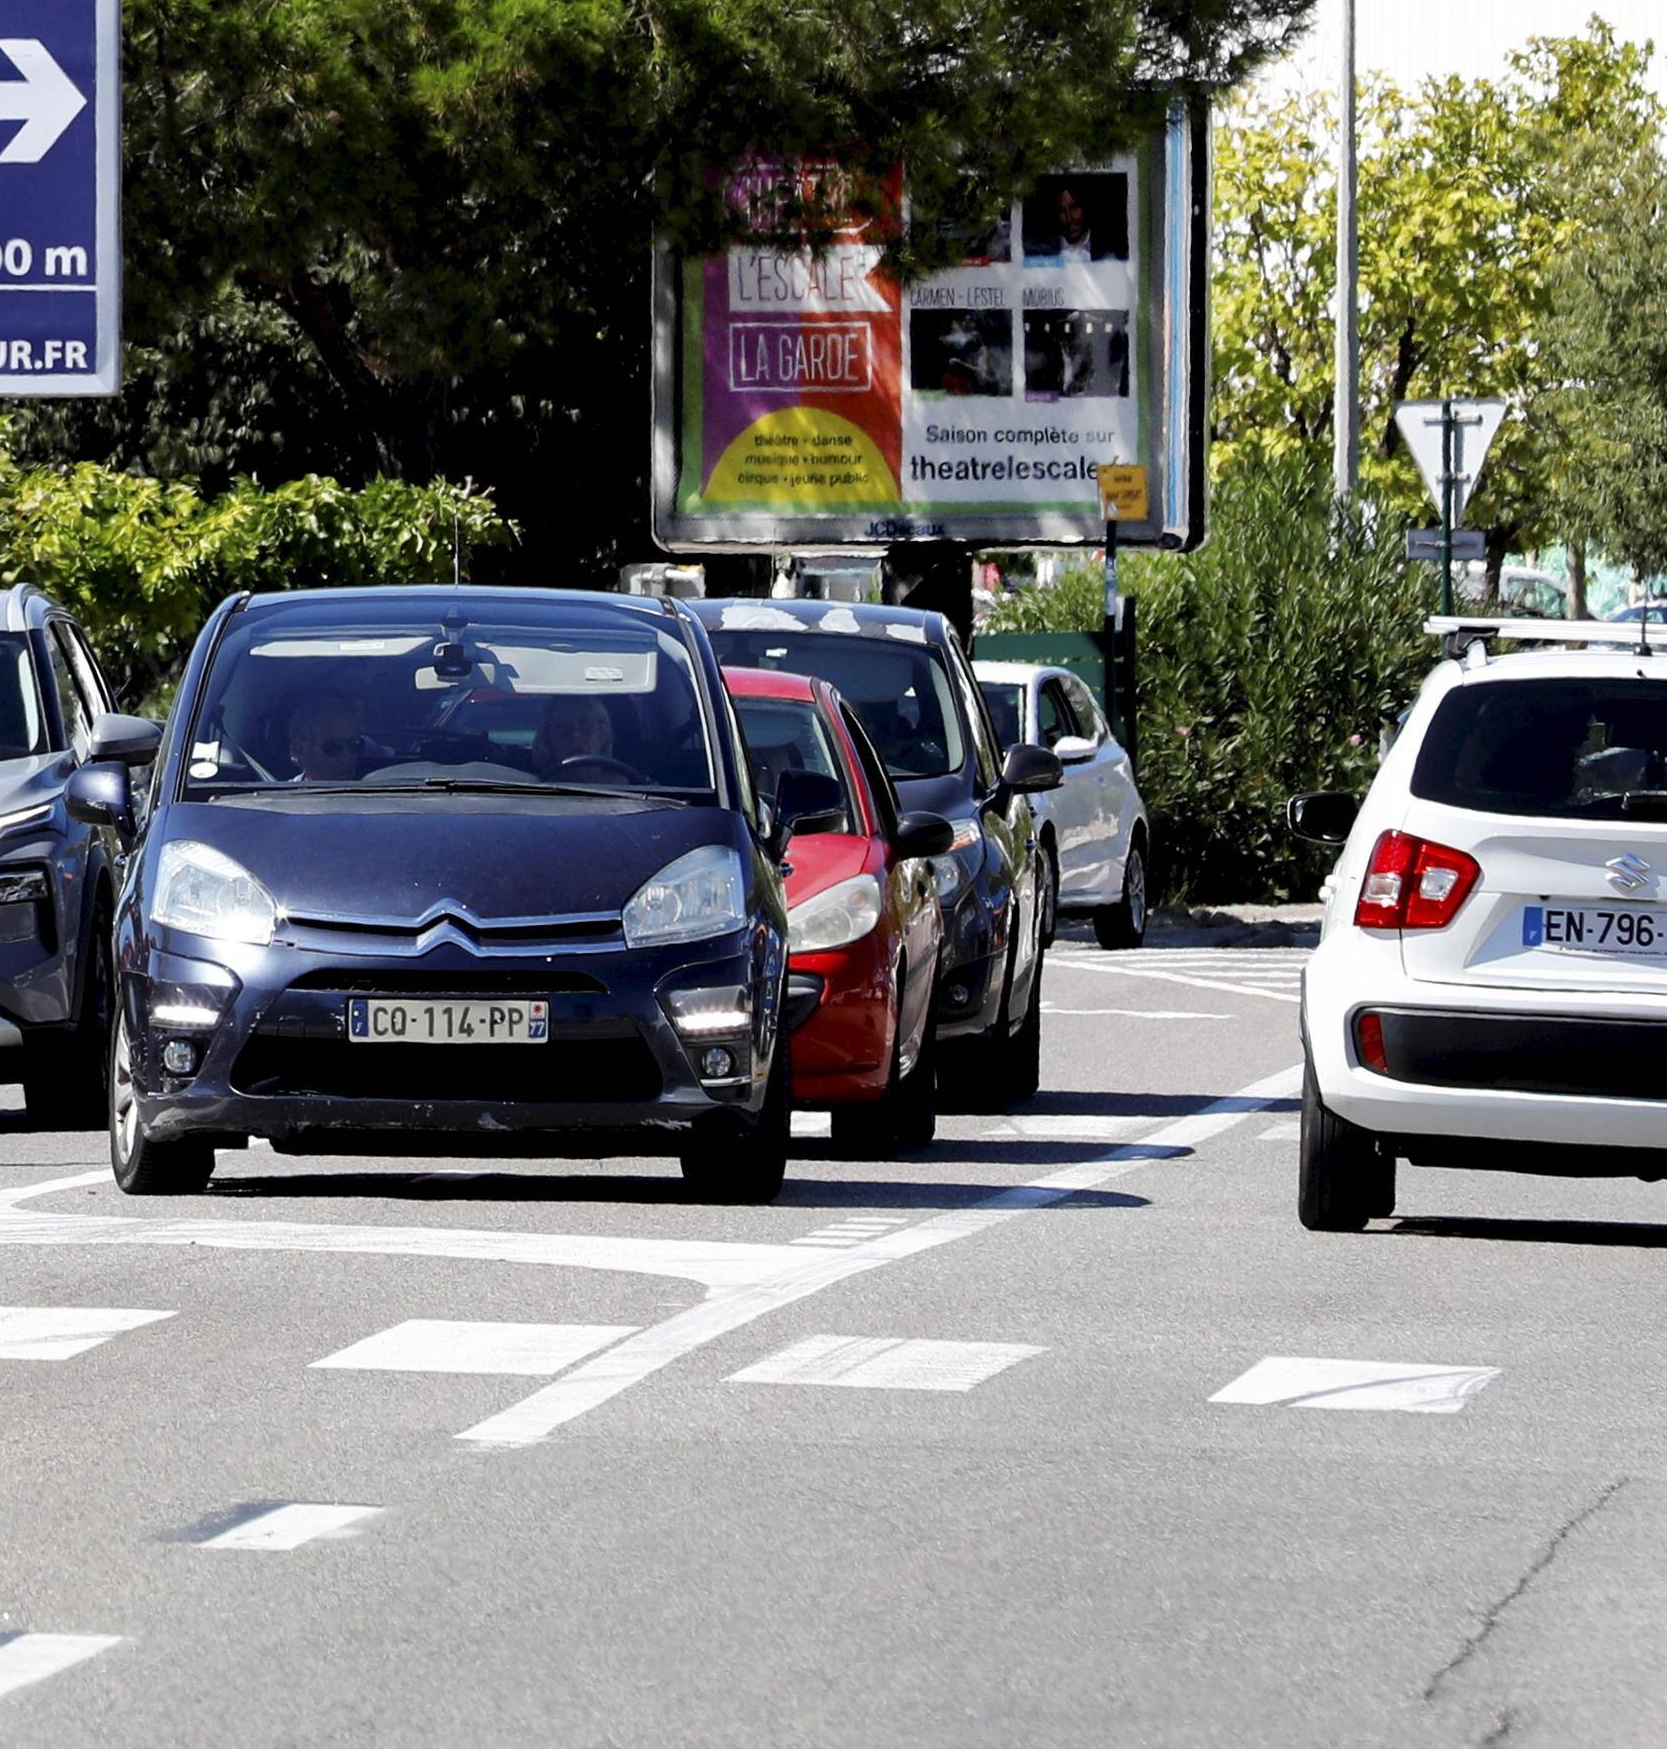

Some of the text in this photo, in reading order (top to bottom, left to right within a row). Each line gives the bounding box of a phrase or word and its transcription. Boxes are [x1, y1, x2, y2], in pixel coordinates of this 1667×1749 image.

[44, 246, 88, 277] m
[737, 255, 855, 302] L'ESCALE
[741, 332, 859, 382] LA GARDE
[811, 433, 853, 446] danse
[926, 424, 1115, 446] Saison complète sur
[829, 472, 868, 487] public
[864, 520, 945, 537] JCDecaux
